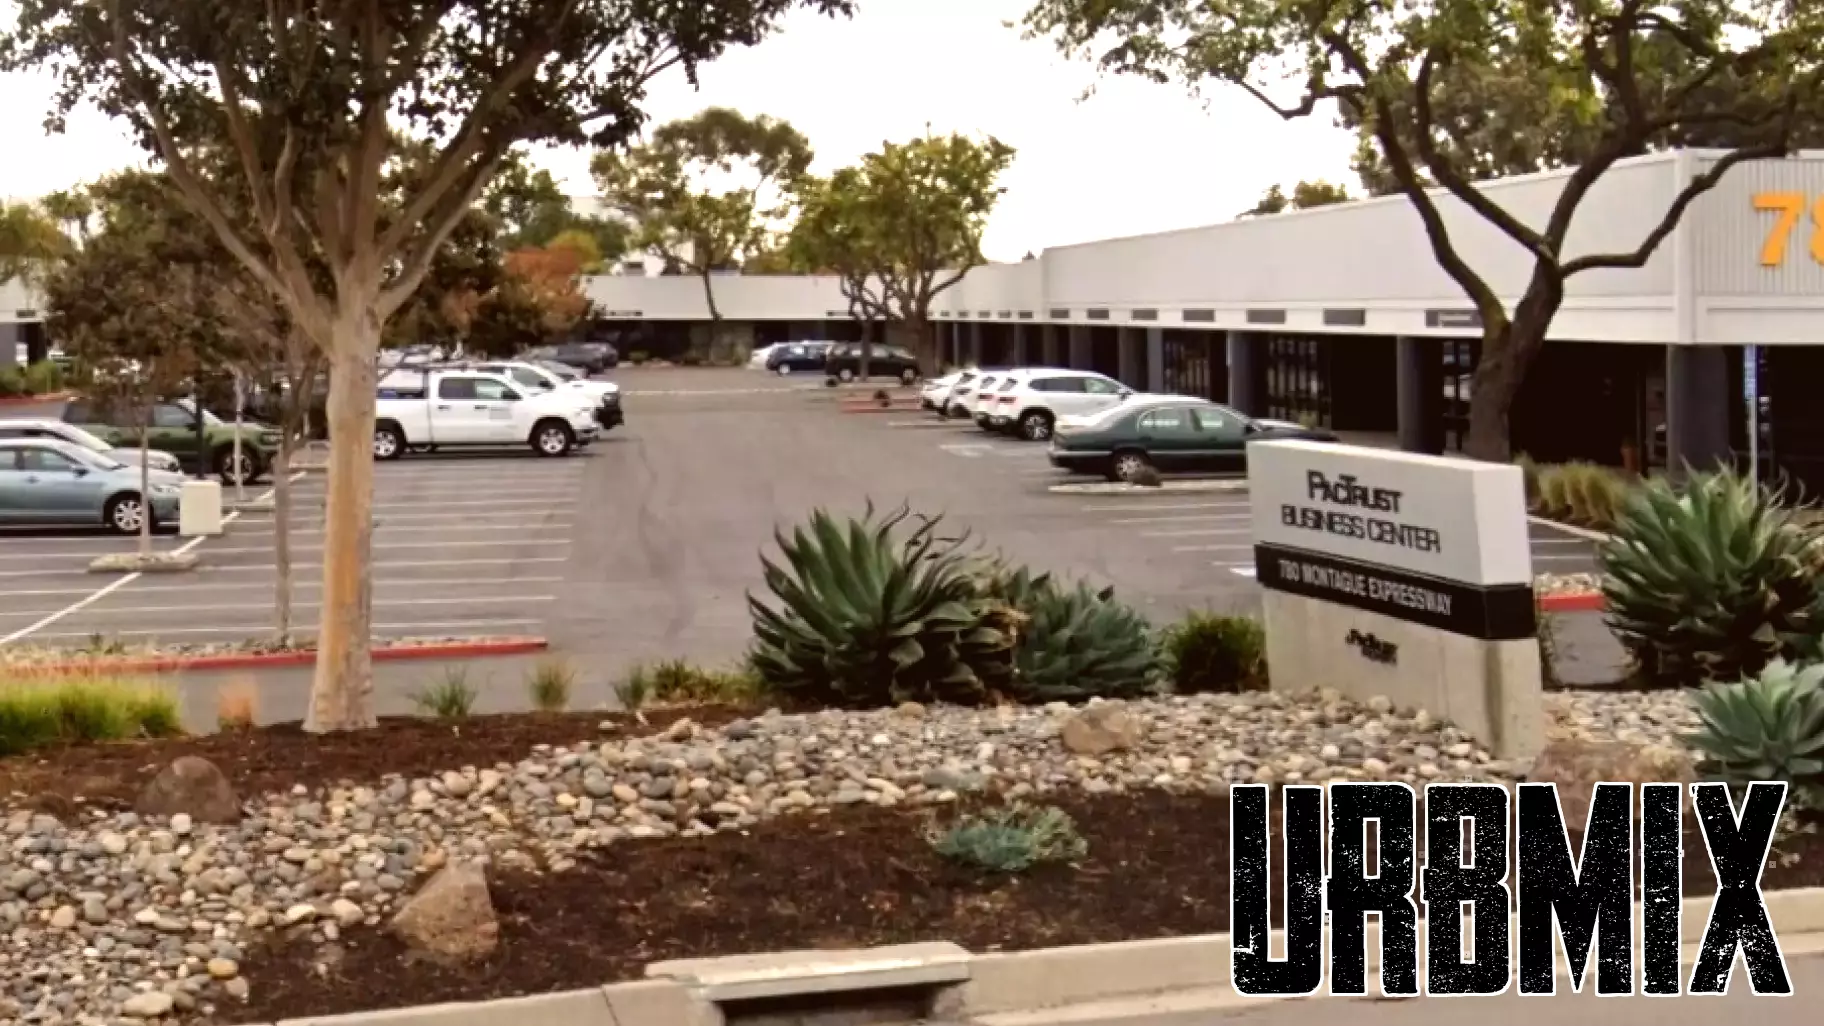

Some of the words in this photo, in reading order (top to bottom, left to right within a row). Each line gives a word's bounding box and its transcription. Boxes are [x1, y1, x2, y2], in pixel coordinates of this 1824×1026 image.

[1752, 191, 1824, 267] 7
[1281, 504, 1365, 539] BUSINESS
[1367, 518, 1441, 553] CENTER
[1301, 562, 1367, 596] MONTAGUE
[1368, 576, 1452, 616] EXPRESSWAY
